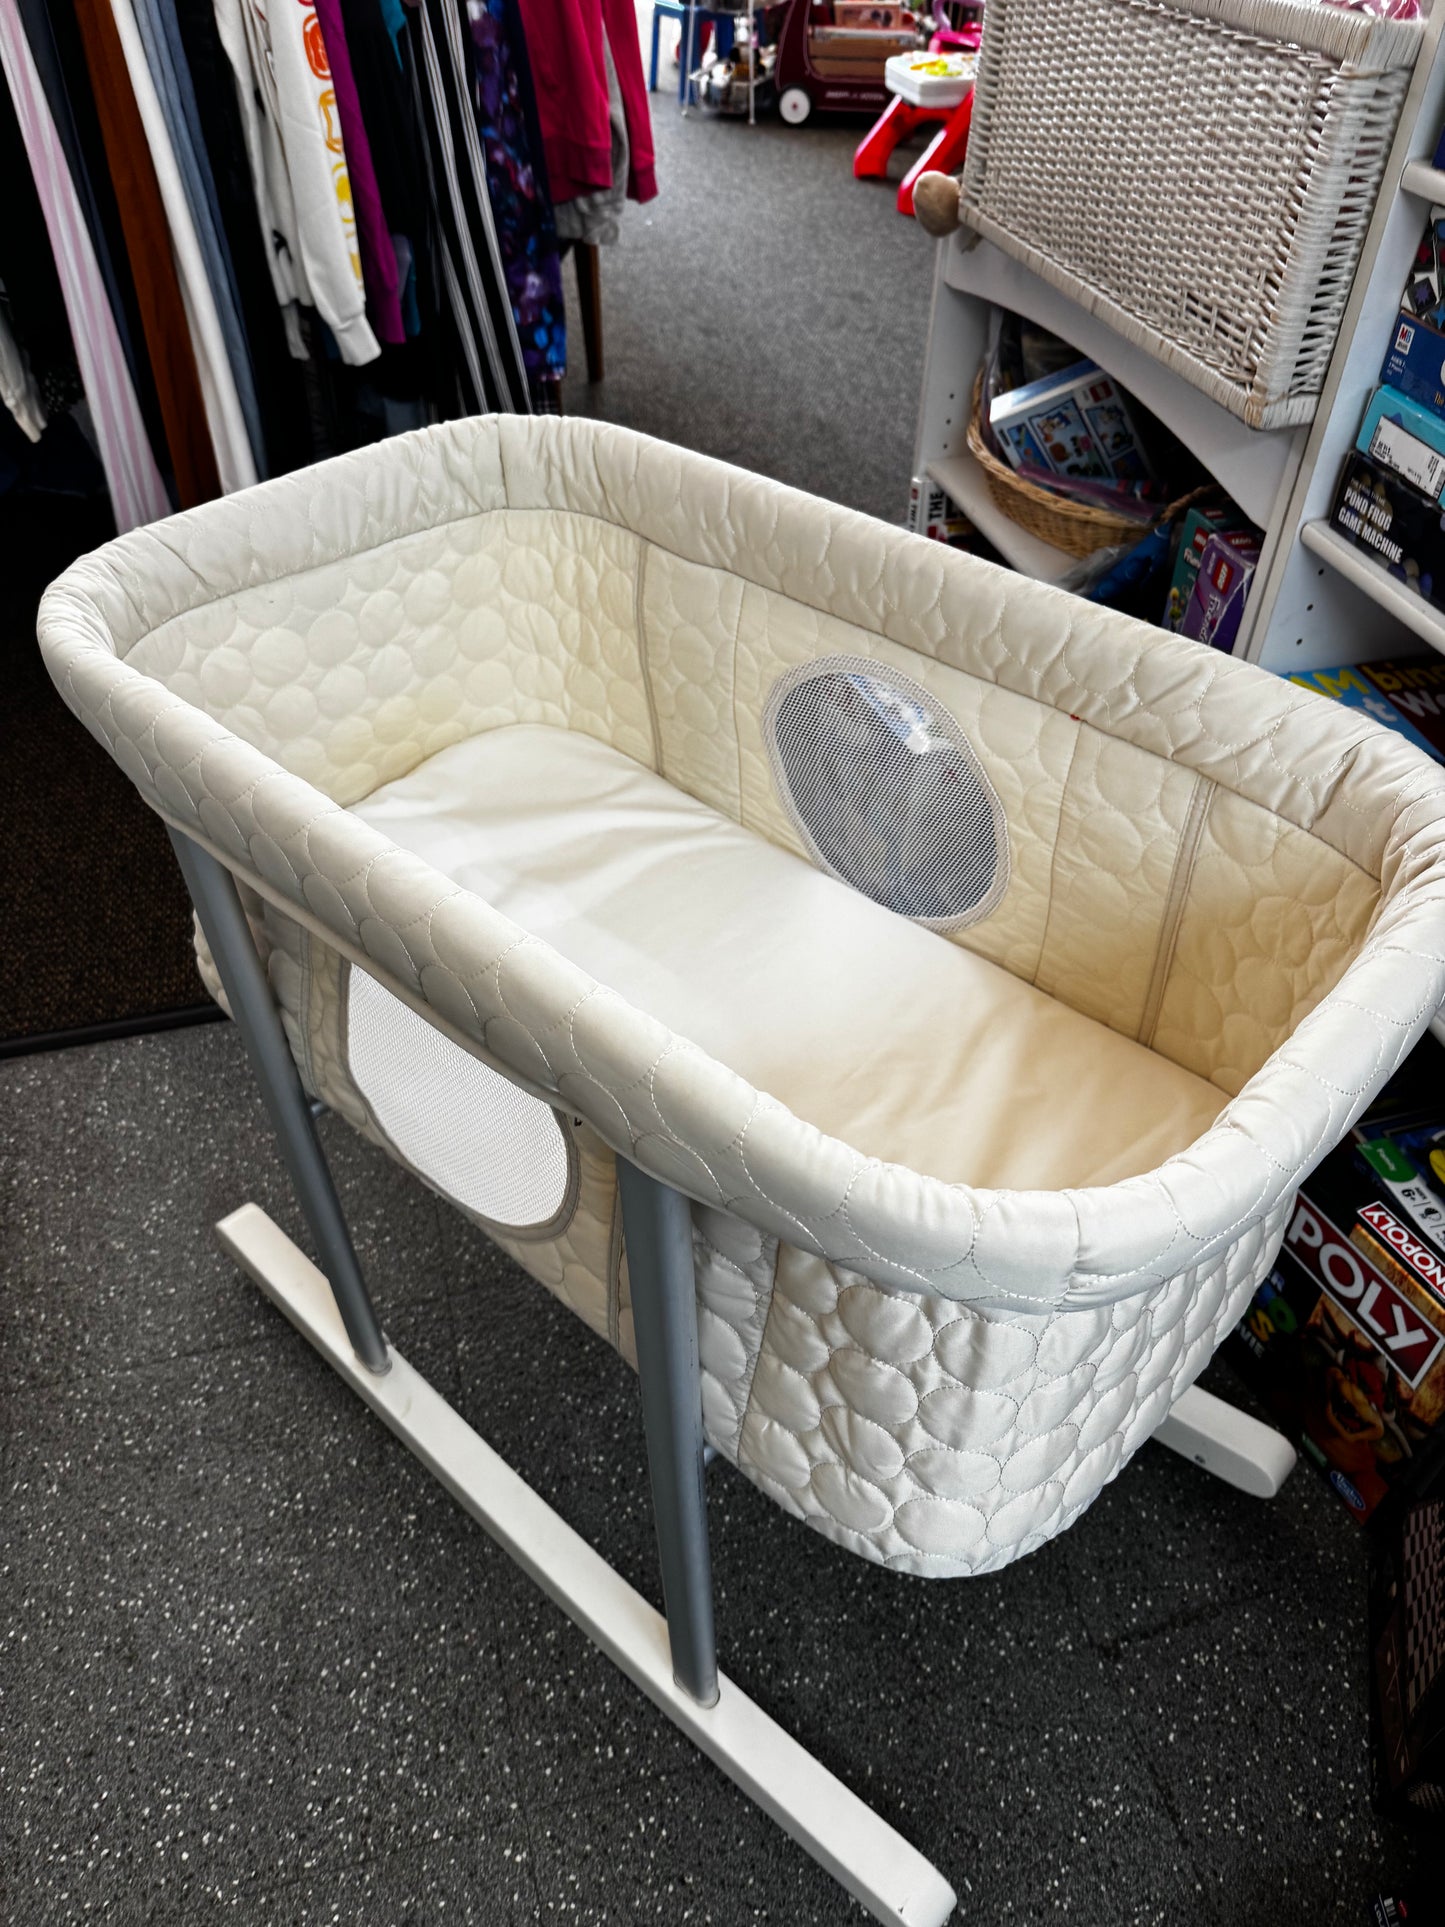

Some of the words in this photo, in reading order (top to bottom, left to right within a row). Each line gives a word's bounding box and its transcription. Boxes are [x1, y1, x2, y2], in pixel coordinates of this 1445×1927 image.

[928, 491, 945, 522] THE
[1344, 486, 1368, 515] POND
[1367, 503, 1393, 532] FROG
[1338, 506, 1364, 535] GAME
[1361, 522, 1403, 564] MACHINE
[1199, 593, 1220, 643] Friend
[1364, 1211, 1445, 1296] NOPOLY
